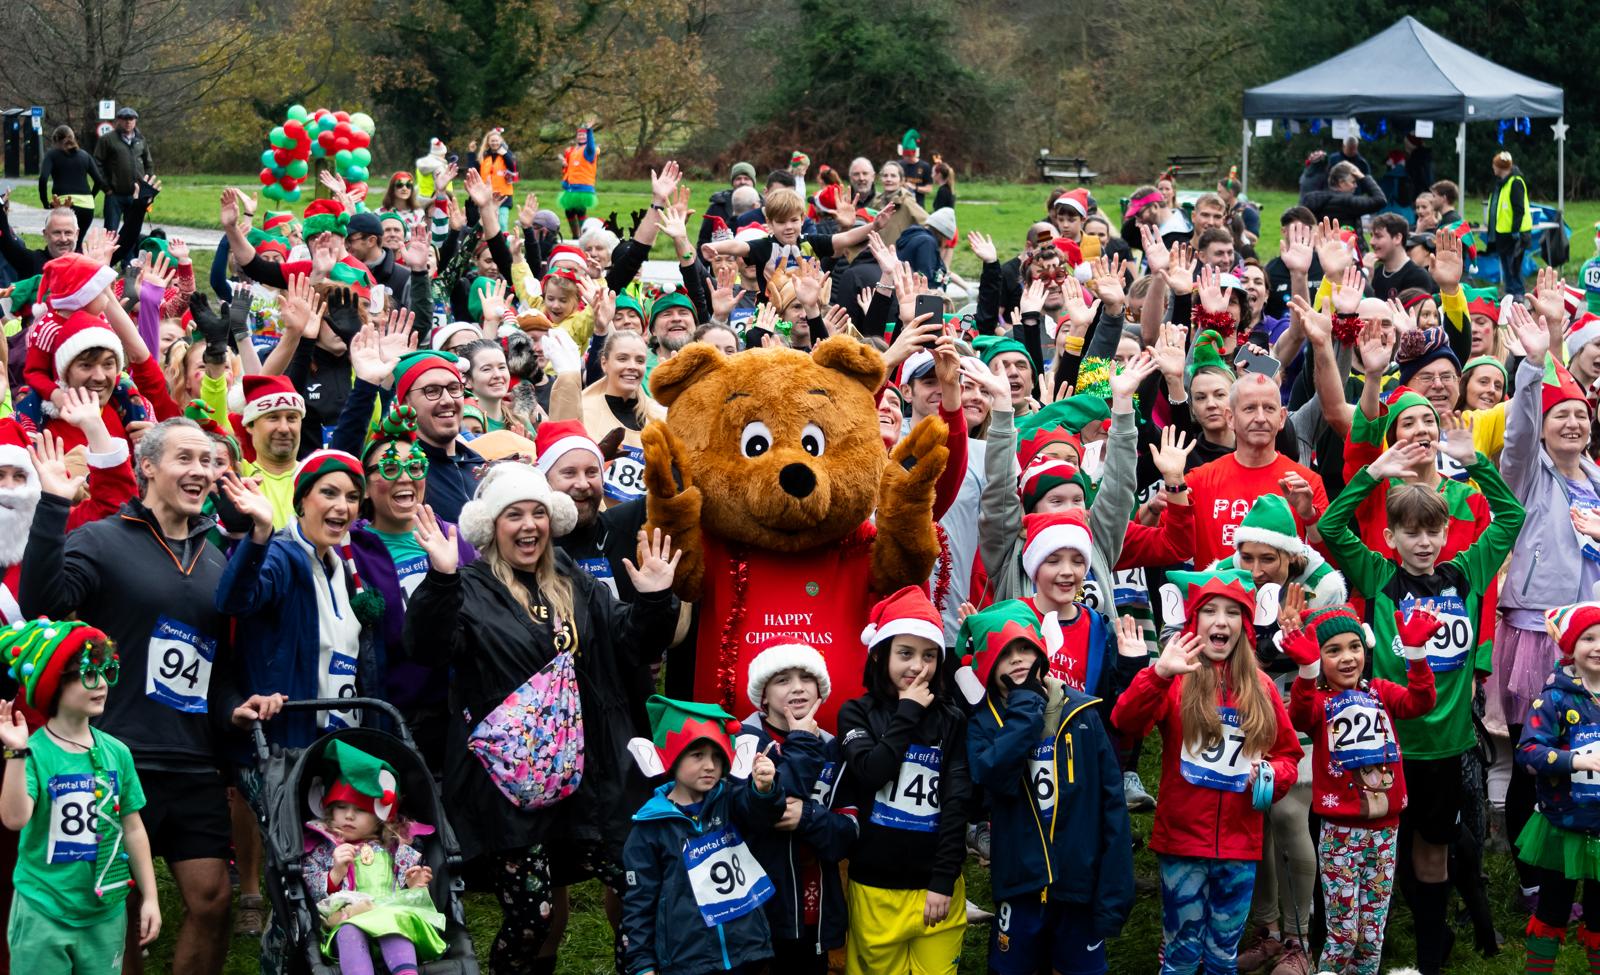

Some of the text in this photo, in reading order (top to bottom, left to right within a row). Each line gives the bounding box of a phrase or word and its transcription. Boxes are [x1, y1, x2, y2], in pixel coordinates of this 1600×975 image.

[1213, 499, 1257, 519] PA
[164, 623, 190, 640] Mental
[764, 613, 813, 626] HAPPY
[1426, 619, 1468, 650] 90
[160, 648, 200, 689] 94
[1051, 653, 1077, 670] PPY
[1332, 712, 1389, 750] 224
[918, 753, 930, 762] Elf
[1201, 733, 1246, 767] 97
[61, 801, 98, 836] 88
[693, 839, 721, 857] Mental
[710, 853, 746, 895] 98
[999, 901, 1012, 932] 9
